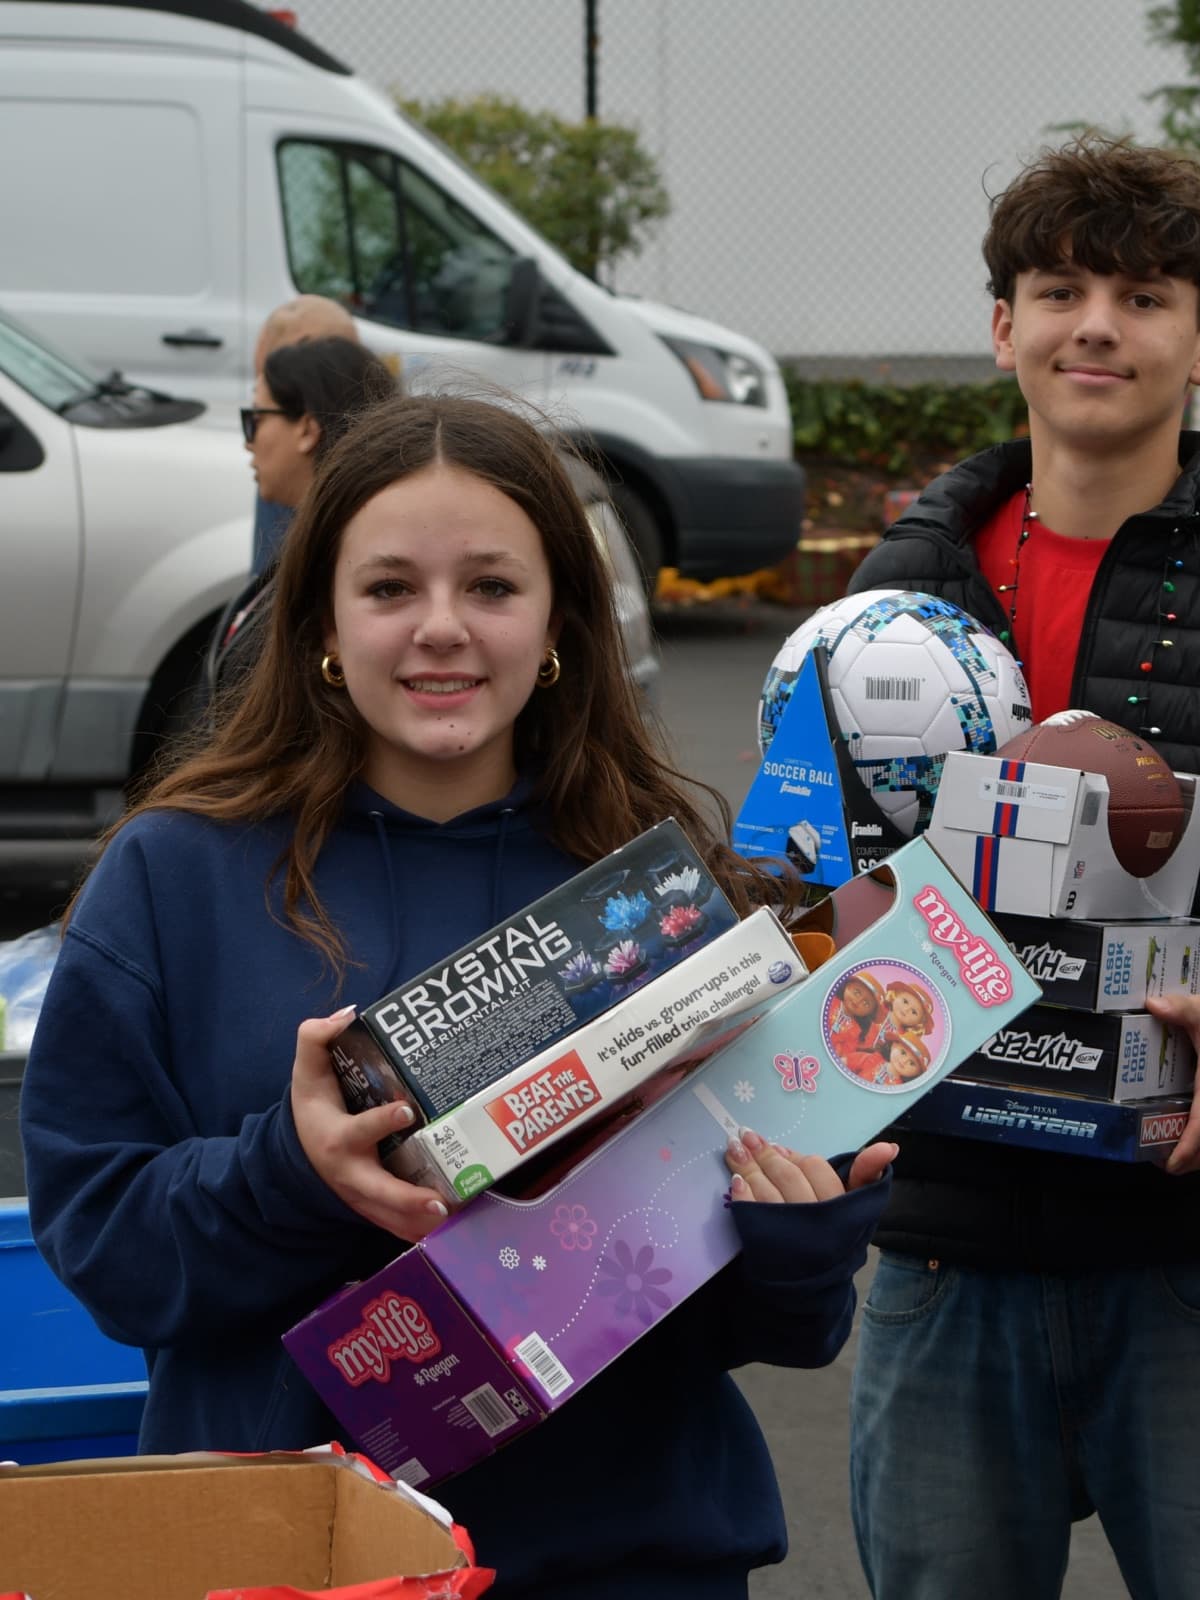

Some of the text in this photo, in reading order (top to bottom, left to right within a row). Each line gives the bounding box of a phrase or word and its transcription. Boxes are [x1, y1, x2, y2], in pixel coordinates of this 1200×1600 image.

[763, 761, 834, 786] SOCCER BALL
[375, 914, 558, 1035] CRYSTAL
[929, 952, 957, 987] Raegan
[1059, 961, 1082, 974] NERF
[1104, 943, 1116, 995] ALSO
[1112, 942, 1124, 995] LOOK
[1121, 950, 1132, 994] FOR:
[390, 928, 573, 1057] GROWING
[597, 950, 762, 1063] It's kids vs. grown-ups in this
[975, 983, 991, 1002] as
[404, 979, 532, 1067] EXPERIMENTAL KIT
[620, 975, 761, 1071] fun-filled trivia challenge!
[980, 1031, 1098, 1070] NERF HYPER
[1121, 1031, 1133, 1083] ALSO
[1129, 1030, 1140, 1082] LOOK
[1136, 1037, 1148, 1082] FOR:
[503, 1071, 553, 1119] BEAT
[554, 1069, 577, 1090] THE
[506, 1079, 598, 1150] PARENTS
[1005, 1099, 1057, 1114] Disney PIXAR
[454, 1158, 466, 1170] 6+
[460, 1172, 483, 1188] Family
[418, 1331, 434, 1348] as
